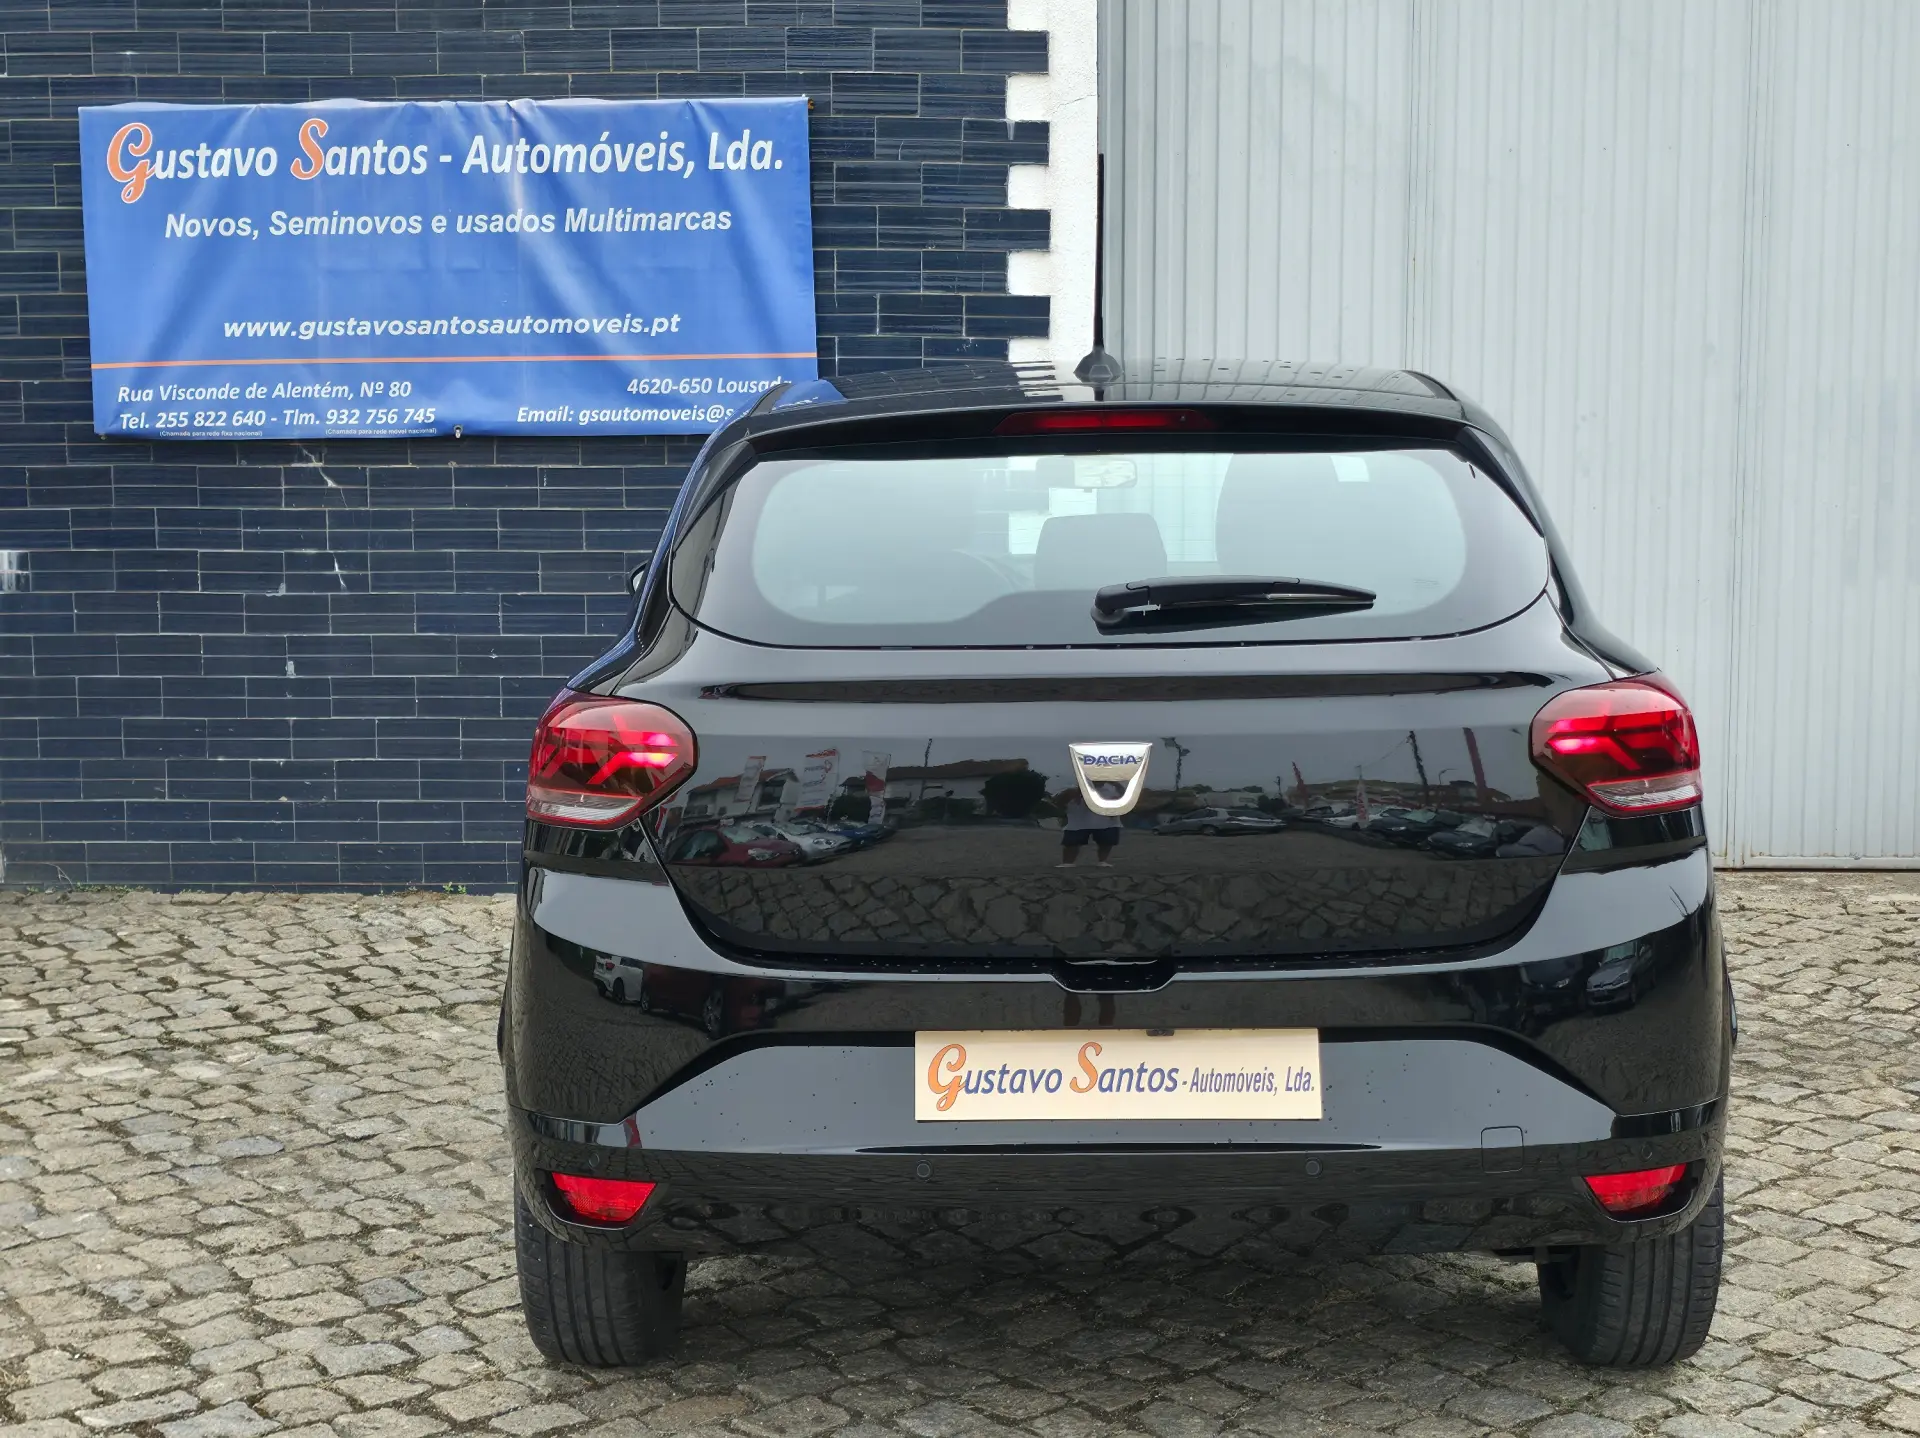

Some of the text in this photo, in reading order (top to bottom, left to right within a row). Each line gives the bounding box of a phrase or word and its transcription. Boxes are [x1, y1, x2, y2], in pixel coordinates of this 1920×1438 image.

[106, 122, 277, 204] Gustavo
[290, 118, 428, 180] Santos
[461, 131, 696, 179] Automóveis,
[708, 129, 783, 171] Lda.
[164, 207, 732, 241] Novos, Seminovos e usados Multimarcas
[223, 313, 681, 341] www.gustavosantosautomoveis.pt
[117, 385, 154, 403] Rua
[159, 383, 241, 402] Visconde
[245, 382, 268, 400] de
[272, 380, 353, 402] Alentém,
[388, 380, 412, 398] 80
[626, 375, 792, 394] 4620-650 Lousad
[120, 412, 150, 430] Tel.
[155, 411, 189, 429] 255
[193, 411, 227, 427] 822
[232, 410, 266, 427] 640
[283, 409, 320, 426] Tlm.
[325, 408, 360, 425] 932
[365, 408, 399, 425] 756
[403, 407, 436, 424] 745
[516, 404, 574, 423] Email:
[1083, 755, 1138, 765] DACIA
[927, 1043, 1062, 1112] Gustavo
[1069, 1041, 1179, 1094] Santos
[1190, 1066, 1278, 1096] Automóveis,
[1285, 1066, 1315, 1092] Lda.
